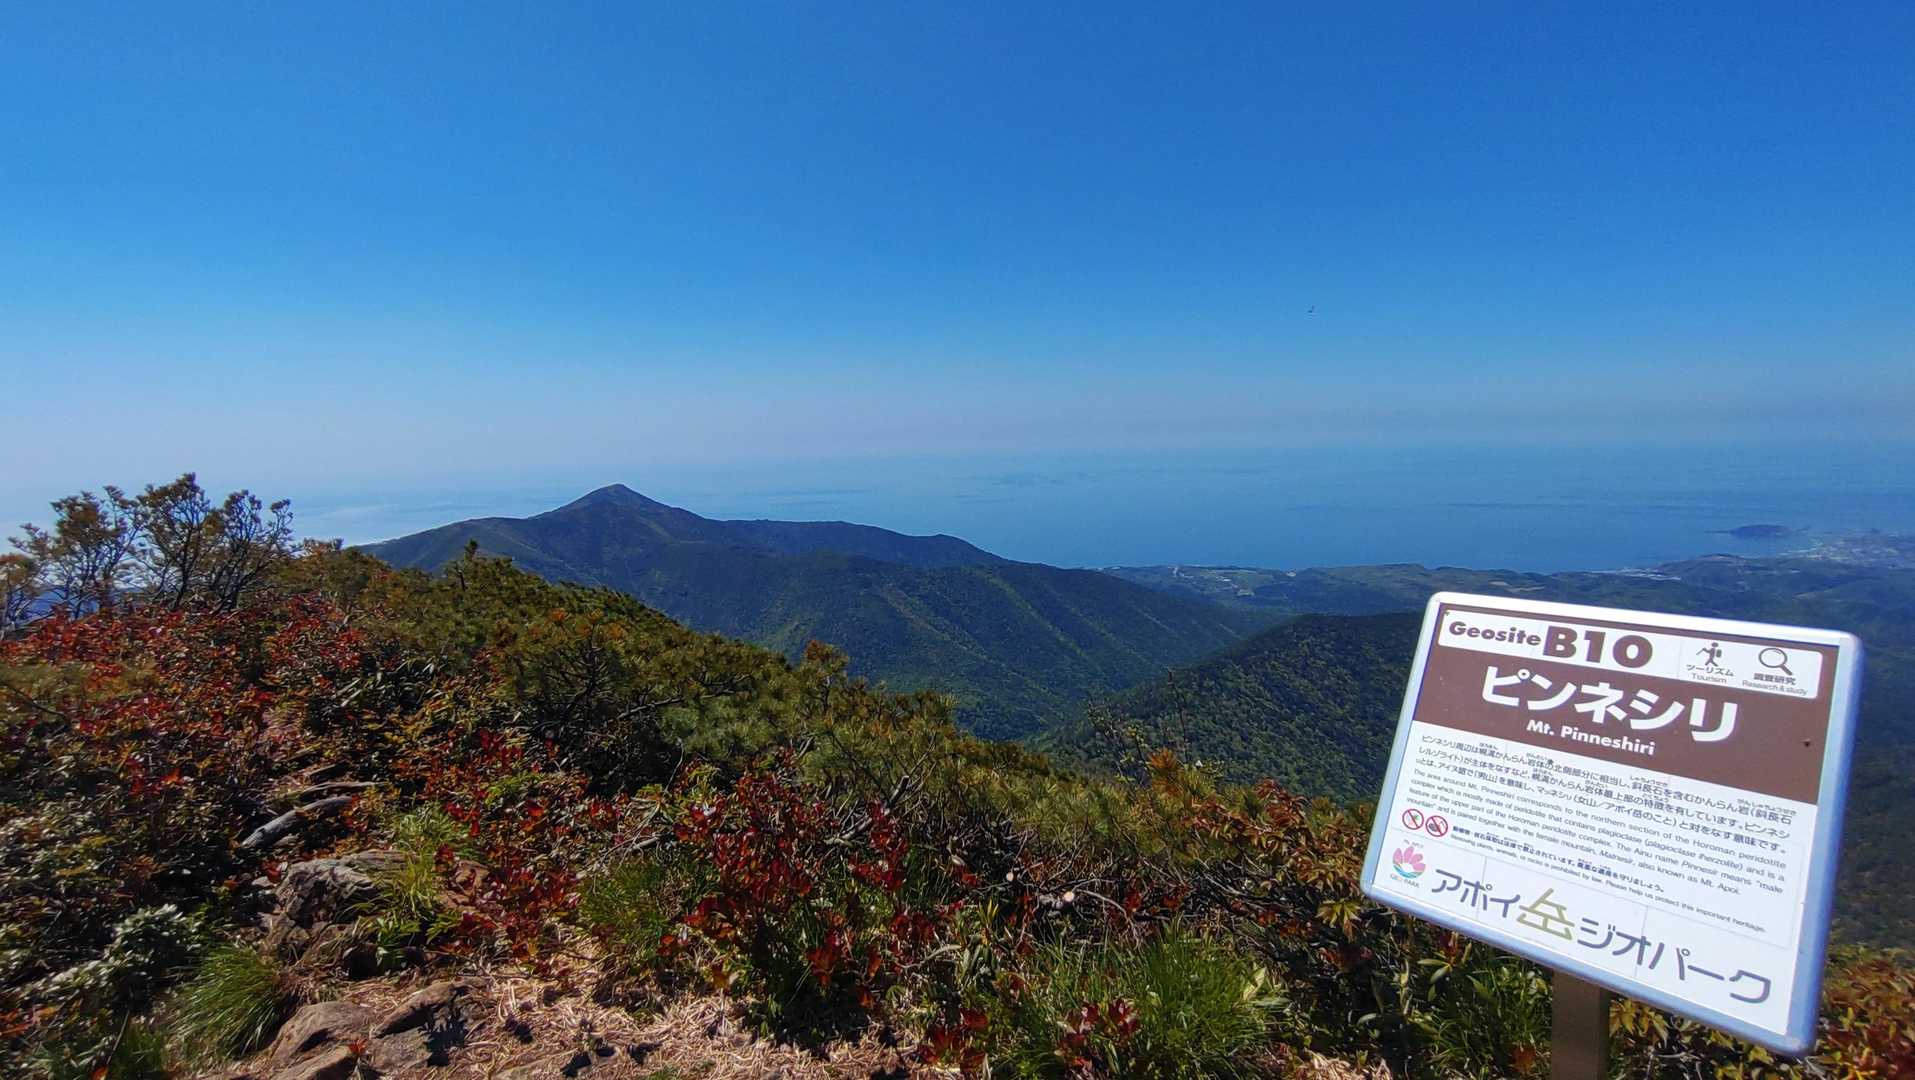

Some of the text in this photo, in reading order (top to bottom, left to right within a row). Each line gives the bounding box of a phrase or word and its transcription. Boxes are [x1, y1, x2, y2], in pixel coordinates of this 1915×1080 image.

[1448, 620, 1654, 669] Geosite B10
[1685, 663, 1734, 677] ツーリズム
[1690, 672, 1727, 683] Tourism
[1480, 665, 1738, 743] ピンネシリ
[1526, 718, 1656, 756] Mt. Pinneshiri
[1413, 768, 1425, 776] The
[1442, 776, 1466, 787] around
[1575, 809, 1589, 818] the
[1591, 813, 1626, 828] northern
[1627, 822, 1660, 836] section
[1674, 834, 1690, 844] the
[1692, 838, 1735, 856] Horoman
[1437, 805, 1449, 813] and
[1506, 824, 1521, 833] with
[1522, 828, 1534, 837] the
[1637, 860, 1655, 870] also
[1656, 865, 1685, 879] known
[1438, 795, 1449, 803] the
[1470, 804, 1484, 813] part
[1494, 810, 1506, 818] the
[1616, 842, 1630, 852] The
[1633, 847, 1652, 858] Ainu
[1654, 854, 1678, 865] name
[1720, 871, 1752, 885] means
[1484, 797, 1503, 807] made
[1547, 813, 1562, 823] that
[1563, 818, 1596, 832] contains
[1597, 826, 1642, 845] plagioclase
[1644, 838, 1696, 859] (plagioclase
[1745, 865, 1764, 876] and
[1431, 869, 1771, 1004] アポイ岳ジオパーク
[1695, 907, 1731, 923] important
